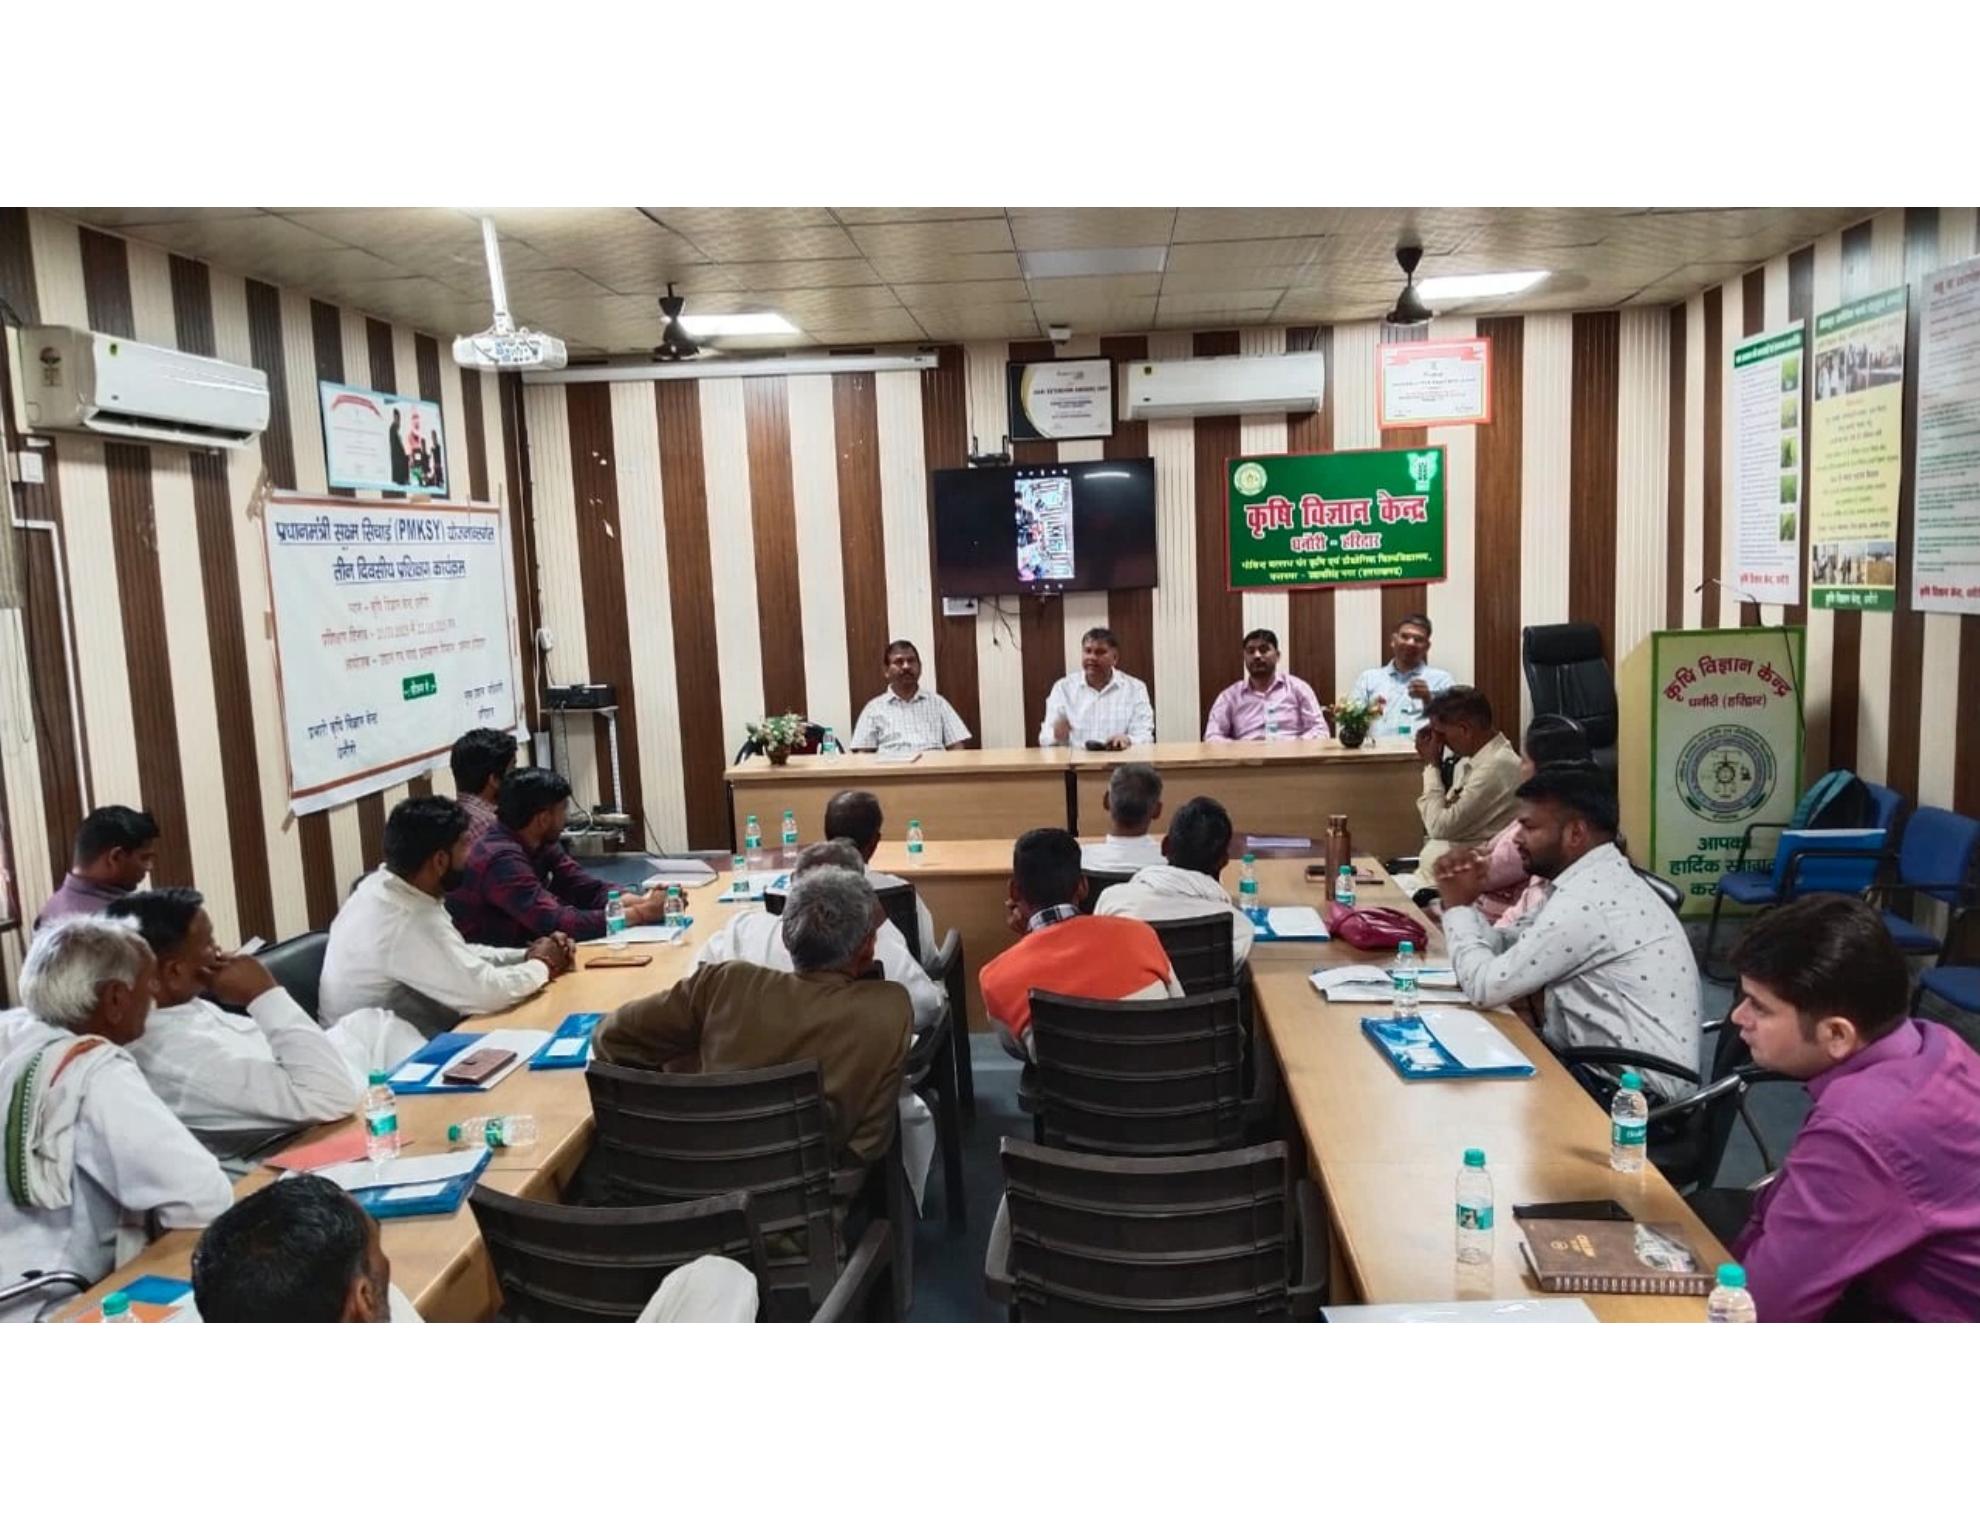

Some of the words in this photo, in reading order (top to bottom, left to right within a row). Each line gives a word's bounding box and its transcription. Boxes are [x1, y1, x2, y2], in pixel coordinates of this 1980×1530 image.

[1243, 495, 1295, 539] कृषि
[1299, 493, 1373, 528] विज्ञान
[1376, 488, 1429, 523] केन्द्र
[276, 516, 331, 541] प्रधानमंत्री
[333, 556, 354, 580] तीन
[356, 555, 395, 580] दिवसीय
[1663, 667, 1697, 702] कृषि
[1698, 655, 1754, 678] विज्ञान
[1757, 661, 1792, 697] केन्द्र
[1669, 854, 1721, 876] हार्दिक
